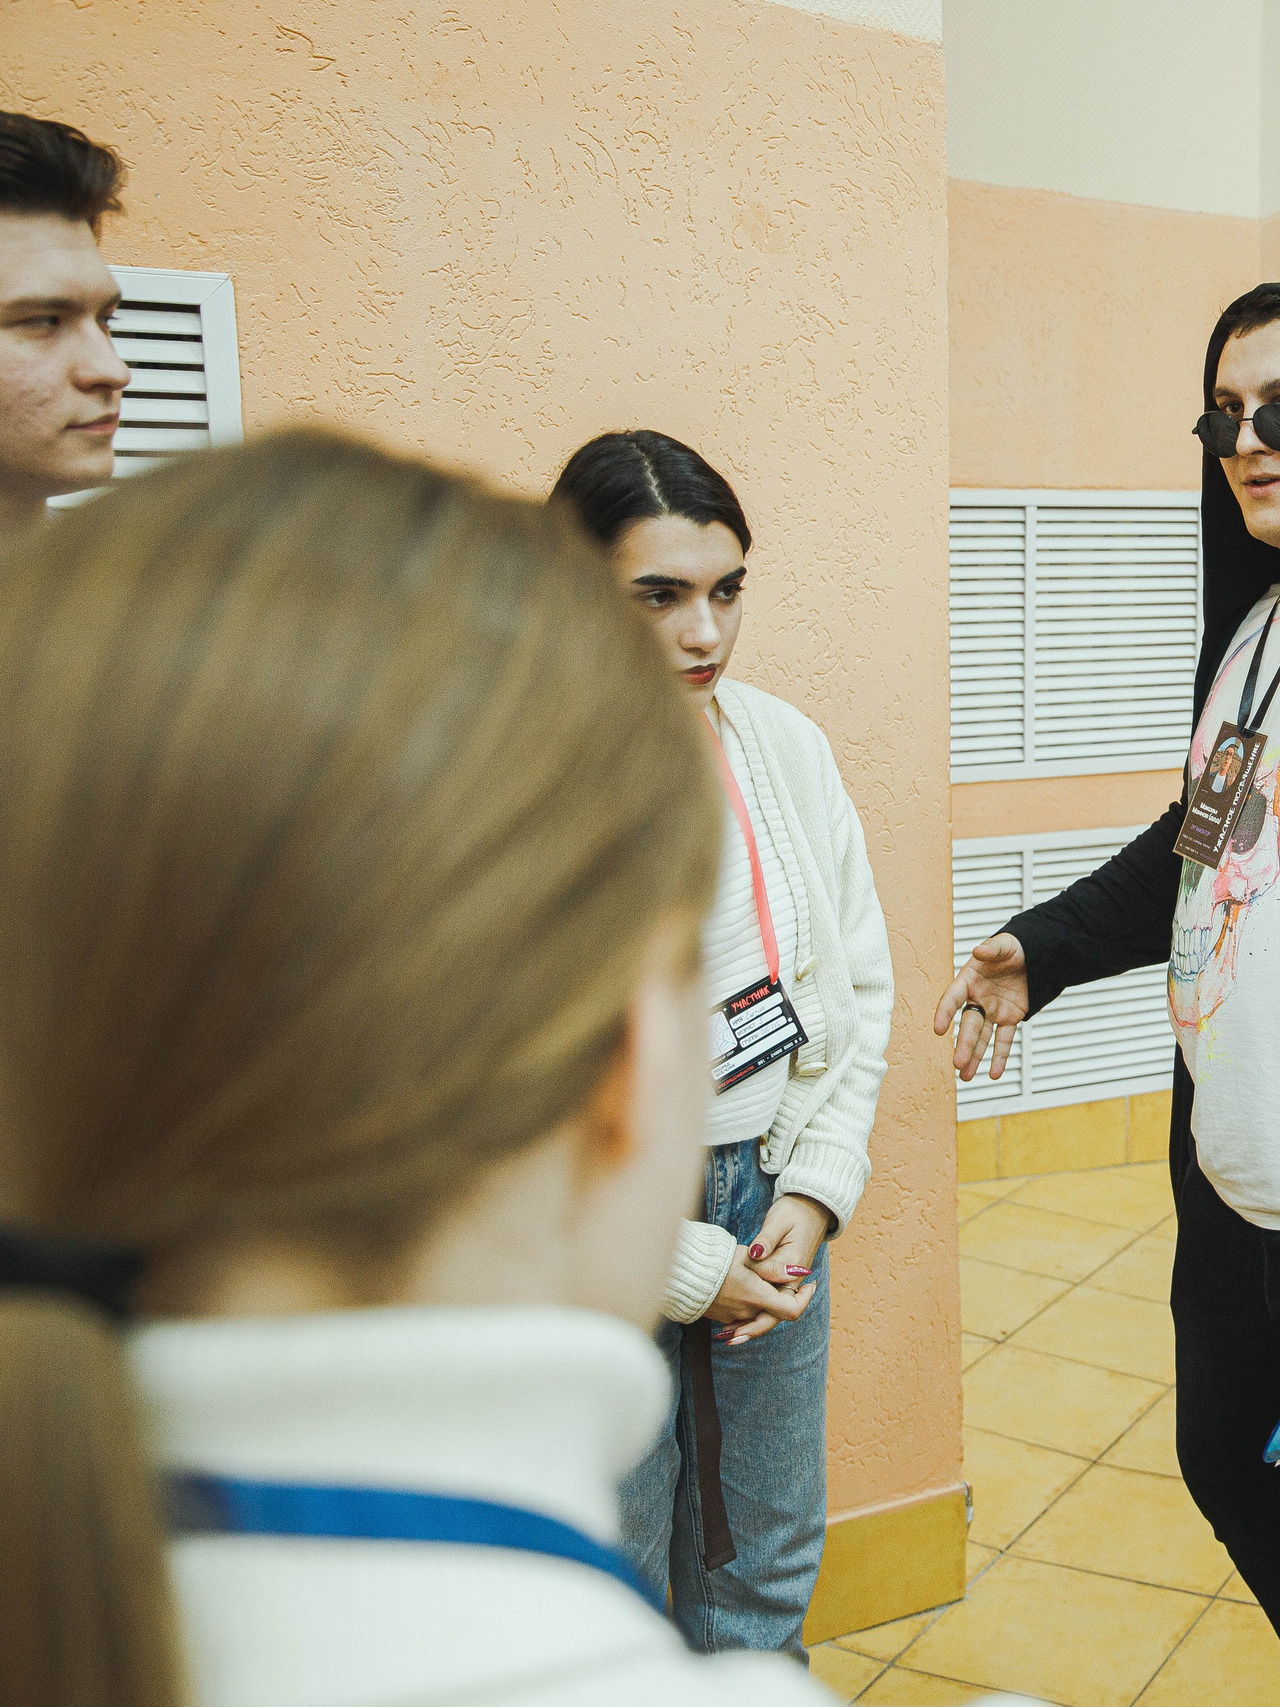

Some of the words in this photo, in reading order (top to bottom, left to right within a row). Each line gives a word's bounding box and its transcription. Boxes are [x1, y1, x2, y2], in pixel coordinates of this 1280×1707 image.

[1212, 807, 1235, 853] УЖАСНОЕ
[1233, 741, 1261, 806] ПОСВЯЩЕНИЕ
[731, 985, 770, 1013] УЧАСТНИК
